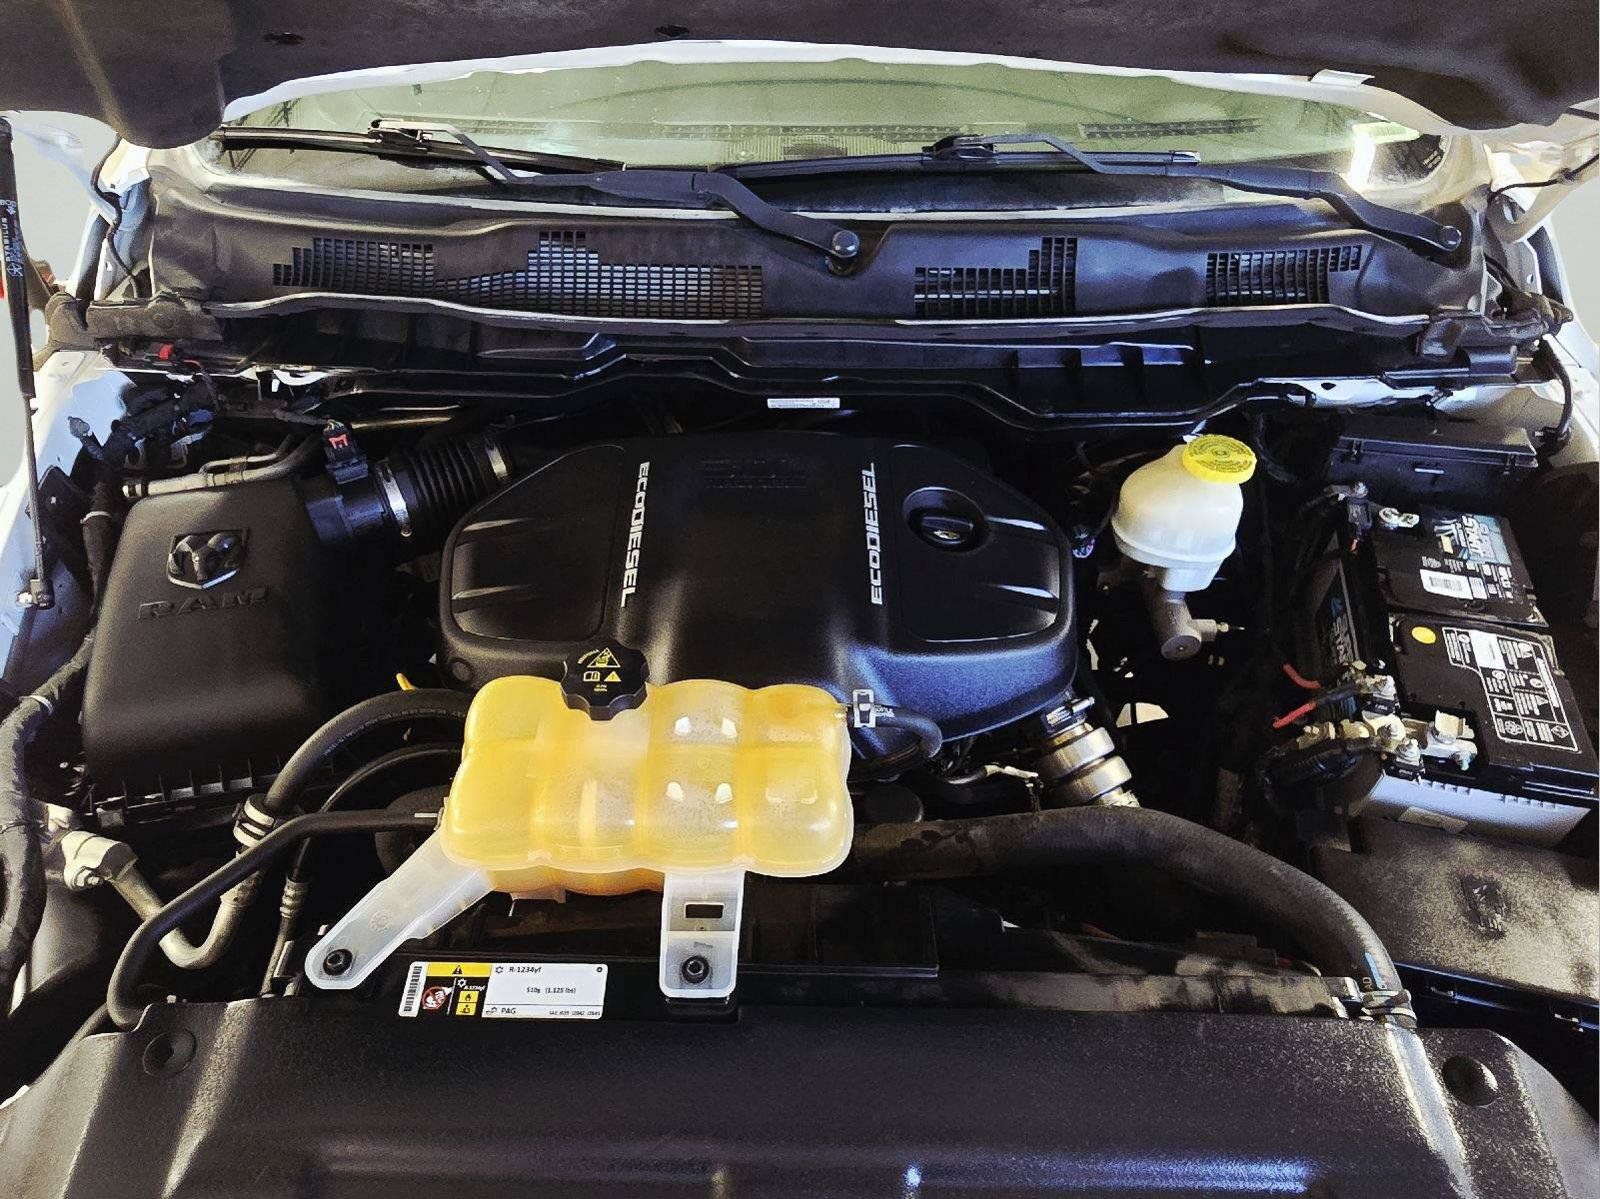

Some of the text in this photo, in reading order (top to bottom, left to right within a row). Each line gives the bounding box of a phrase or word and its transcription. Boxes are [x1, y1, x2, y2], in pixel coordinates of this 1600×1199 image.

[620, 461, 650, 608] ECODIESEL
[861, 462, 883, 605] ECODIESEL
[509, 966, 542, 974] R-1234yf
[500, 1006, 517, 1015] PAG
